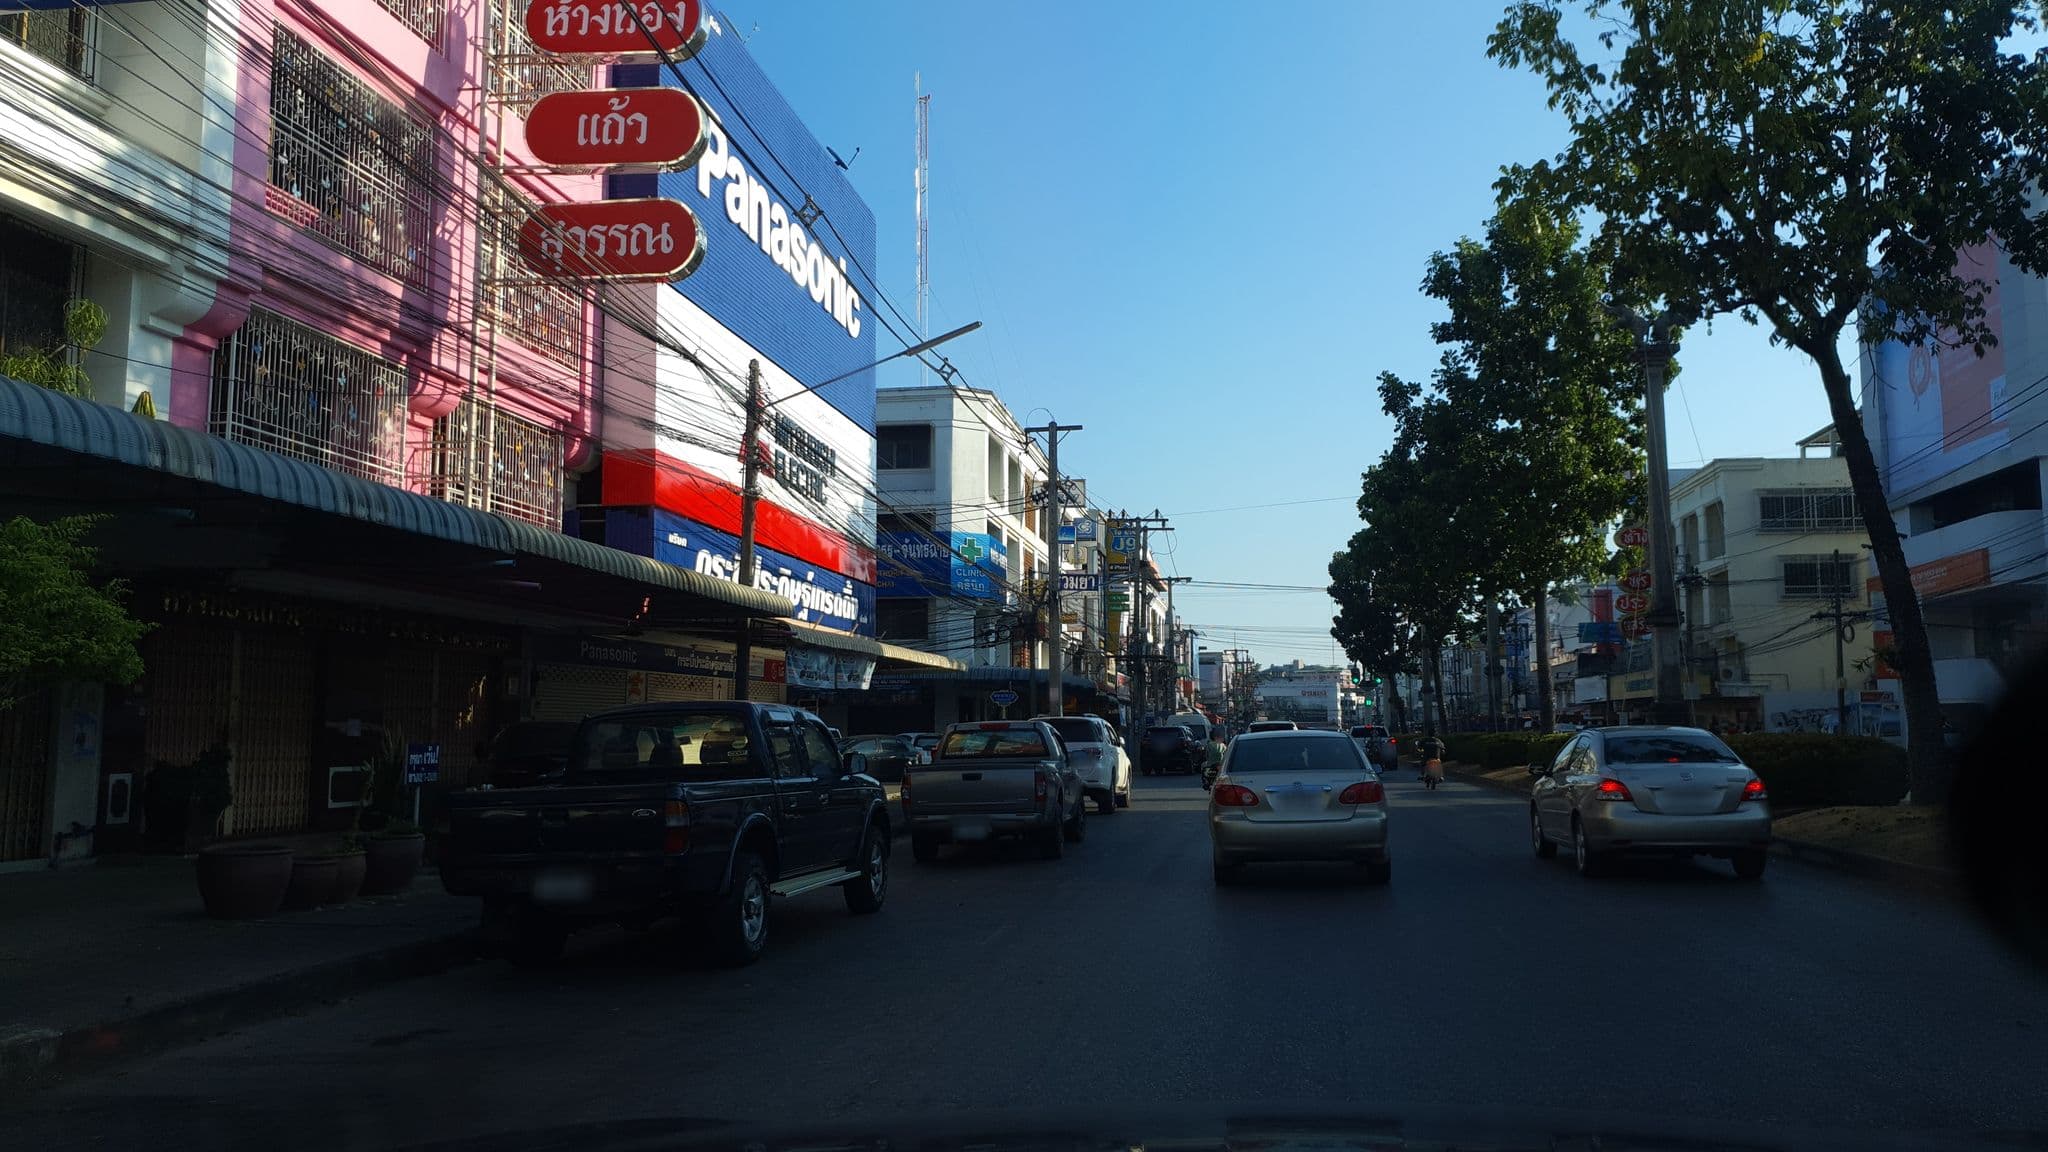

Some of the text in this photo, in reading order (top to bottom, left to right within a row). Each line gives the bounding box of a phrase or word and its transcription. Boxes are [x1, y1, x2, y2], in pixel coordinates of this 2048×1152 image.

[578, 95, 648, 145] แก้ว
[541, 220, 674, 272] สุวรรณ
[697, 110, 861, 339] Panasonic
[775, 449, 829, 506] ELECTRIC
[580, 639, 639, 664] Panasonic
